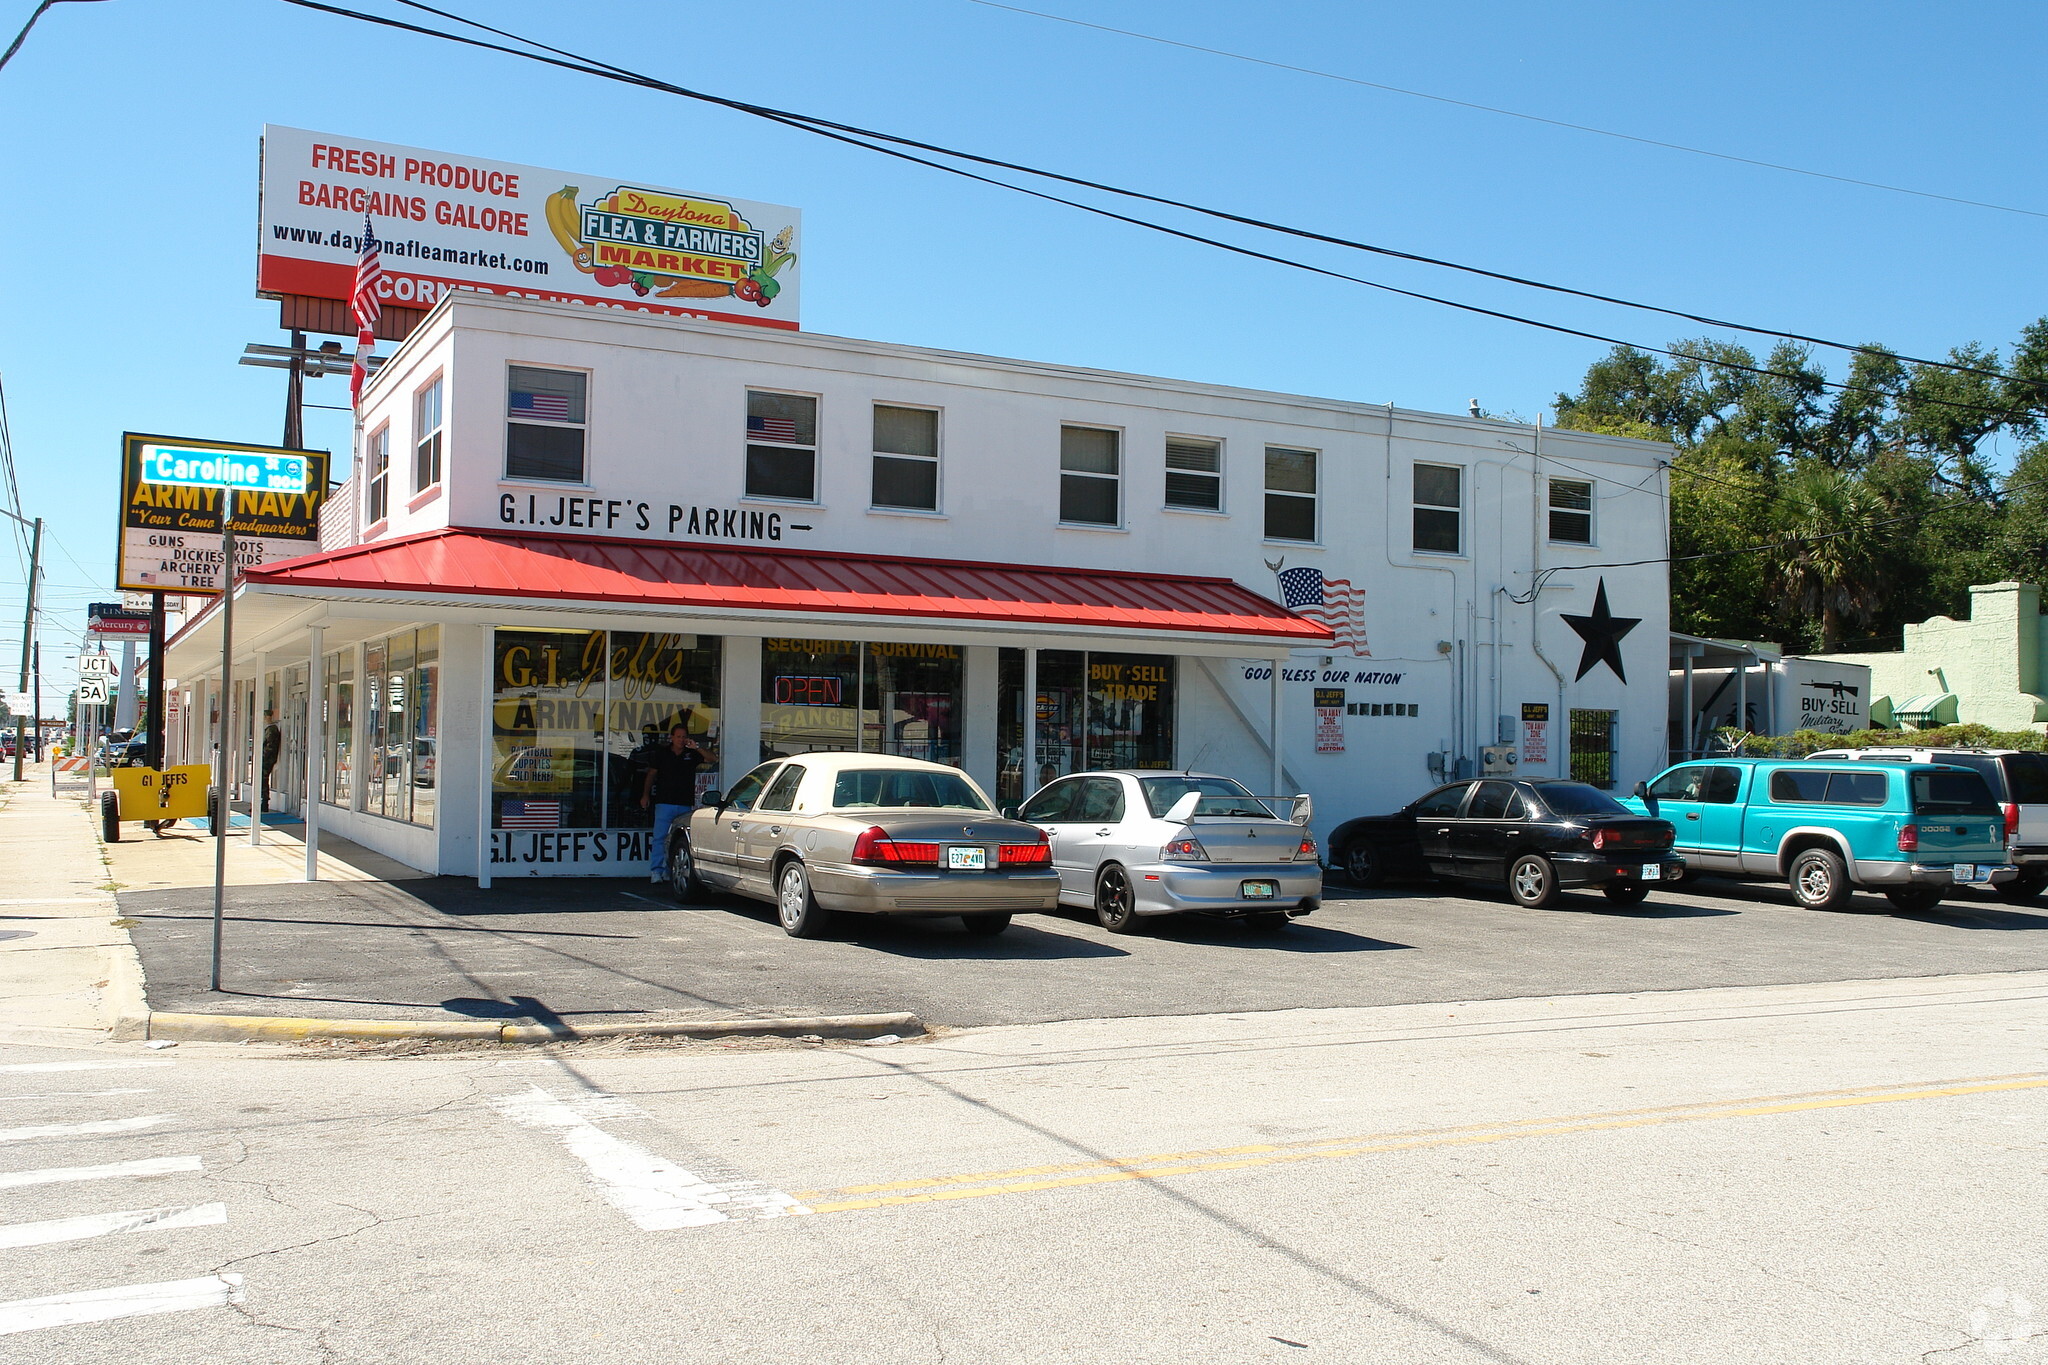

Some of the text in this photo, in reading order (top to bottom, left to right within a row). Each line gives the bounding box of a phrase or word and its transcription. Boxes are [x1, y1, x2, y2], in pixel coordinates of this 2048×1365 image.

[312, 143, 520, 199] FRESH PRODUCE
[298, 180, 529, 237] BARGAINS GALORE
[623, 193, 726, 226] Daytona
[587, 214, 758, 259] FLEA & FARMERS
[273, 225, 549, 275] www.dayonafleamarket.com
[600, 245, 745, 279] MARKET
[375, 274, 494, 304] CORN
[156, 452, 280, 484] Caroline St
[132, 482, 319, 520] ARMY NAVY
[178, 512, 215, 528] Camo
[669, 504, 781, 542] PARKING
[149, 535, 185, 547] GUNS
[222, 540, 264, 553] OOTS
[174, 549, 225, 563] DICKIES
[234, 553, 263, 565] KIDS
[160, 561, 220, 575] ARCHERY
[181, 575, 214, 588] TREE
[95, 620, 134, 630] Mercury
[767, 637, 959, 659] SECURITY SURVIVAL
[83, 658, 107, 670] JCT
[502, 629, 684, 700] G.I. Jeff's
[1091, 664, 1167, 682] BUY SELL
[1322, 670, 1350, 682] OUR
[80, 686, 102, 699] 5A
[777, 677, 840, 704] OPEN
[1106, 684, 1157, 701] TRADE
[1801, 713, 1844, 728] Military
[511, 746, 553, 757] PAINTBALL
[513, 759, 551, 769] SUPPLIES
[142, 773, 188, 787] GI JEFFS
[509, 771, 529, 781] SOLD
[694, 785, 708, 794] ONE
[523, 831, 608, 863] JEFF'S
